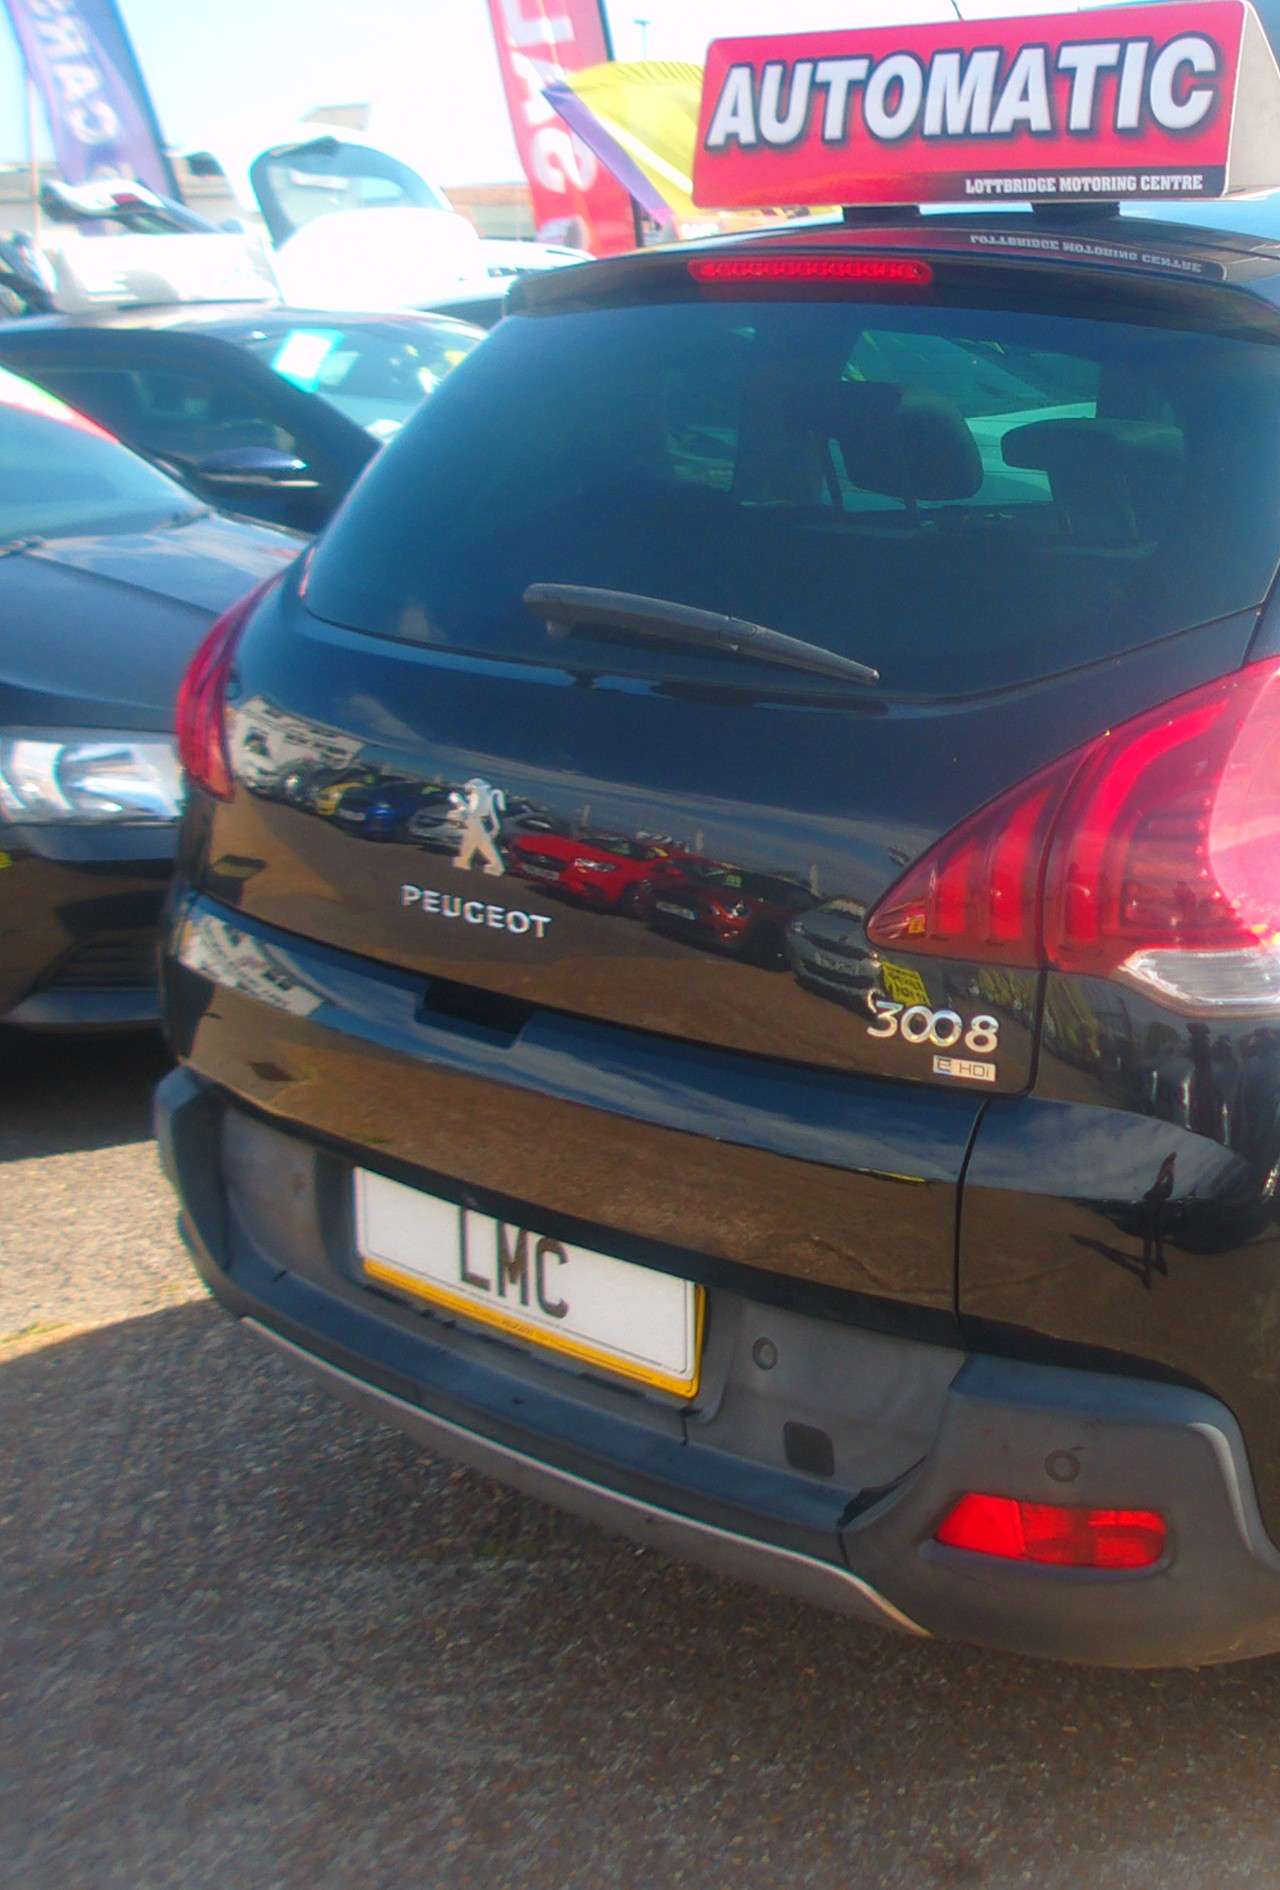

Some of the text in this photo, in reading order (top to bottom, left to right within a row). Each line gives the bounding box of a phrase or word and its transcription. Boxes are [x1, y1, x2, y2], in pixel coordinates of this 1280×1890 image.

[705, 36, 1217, 148] AUTOMATIC
[965, 175, 1202, 194] LOTTBRIDGE MOTORING CENTRE
[401, 884, 552, 938] PEUGEOT
[866, 987, 999, 1053] 3008
[460, 1205, 569, 1319] LMC
